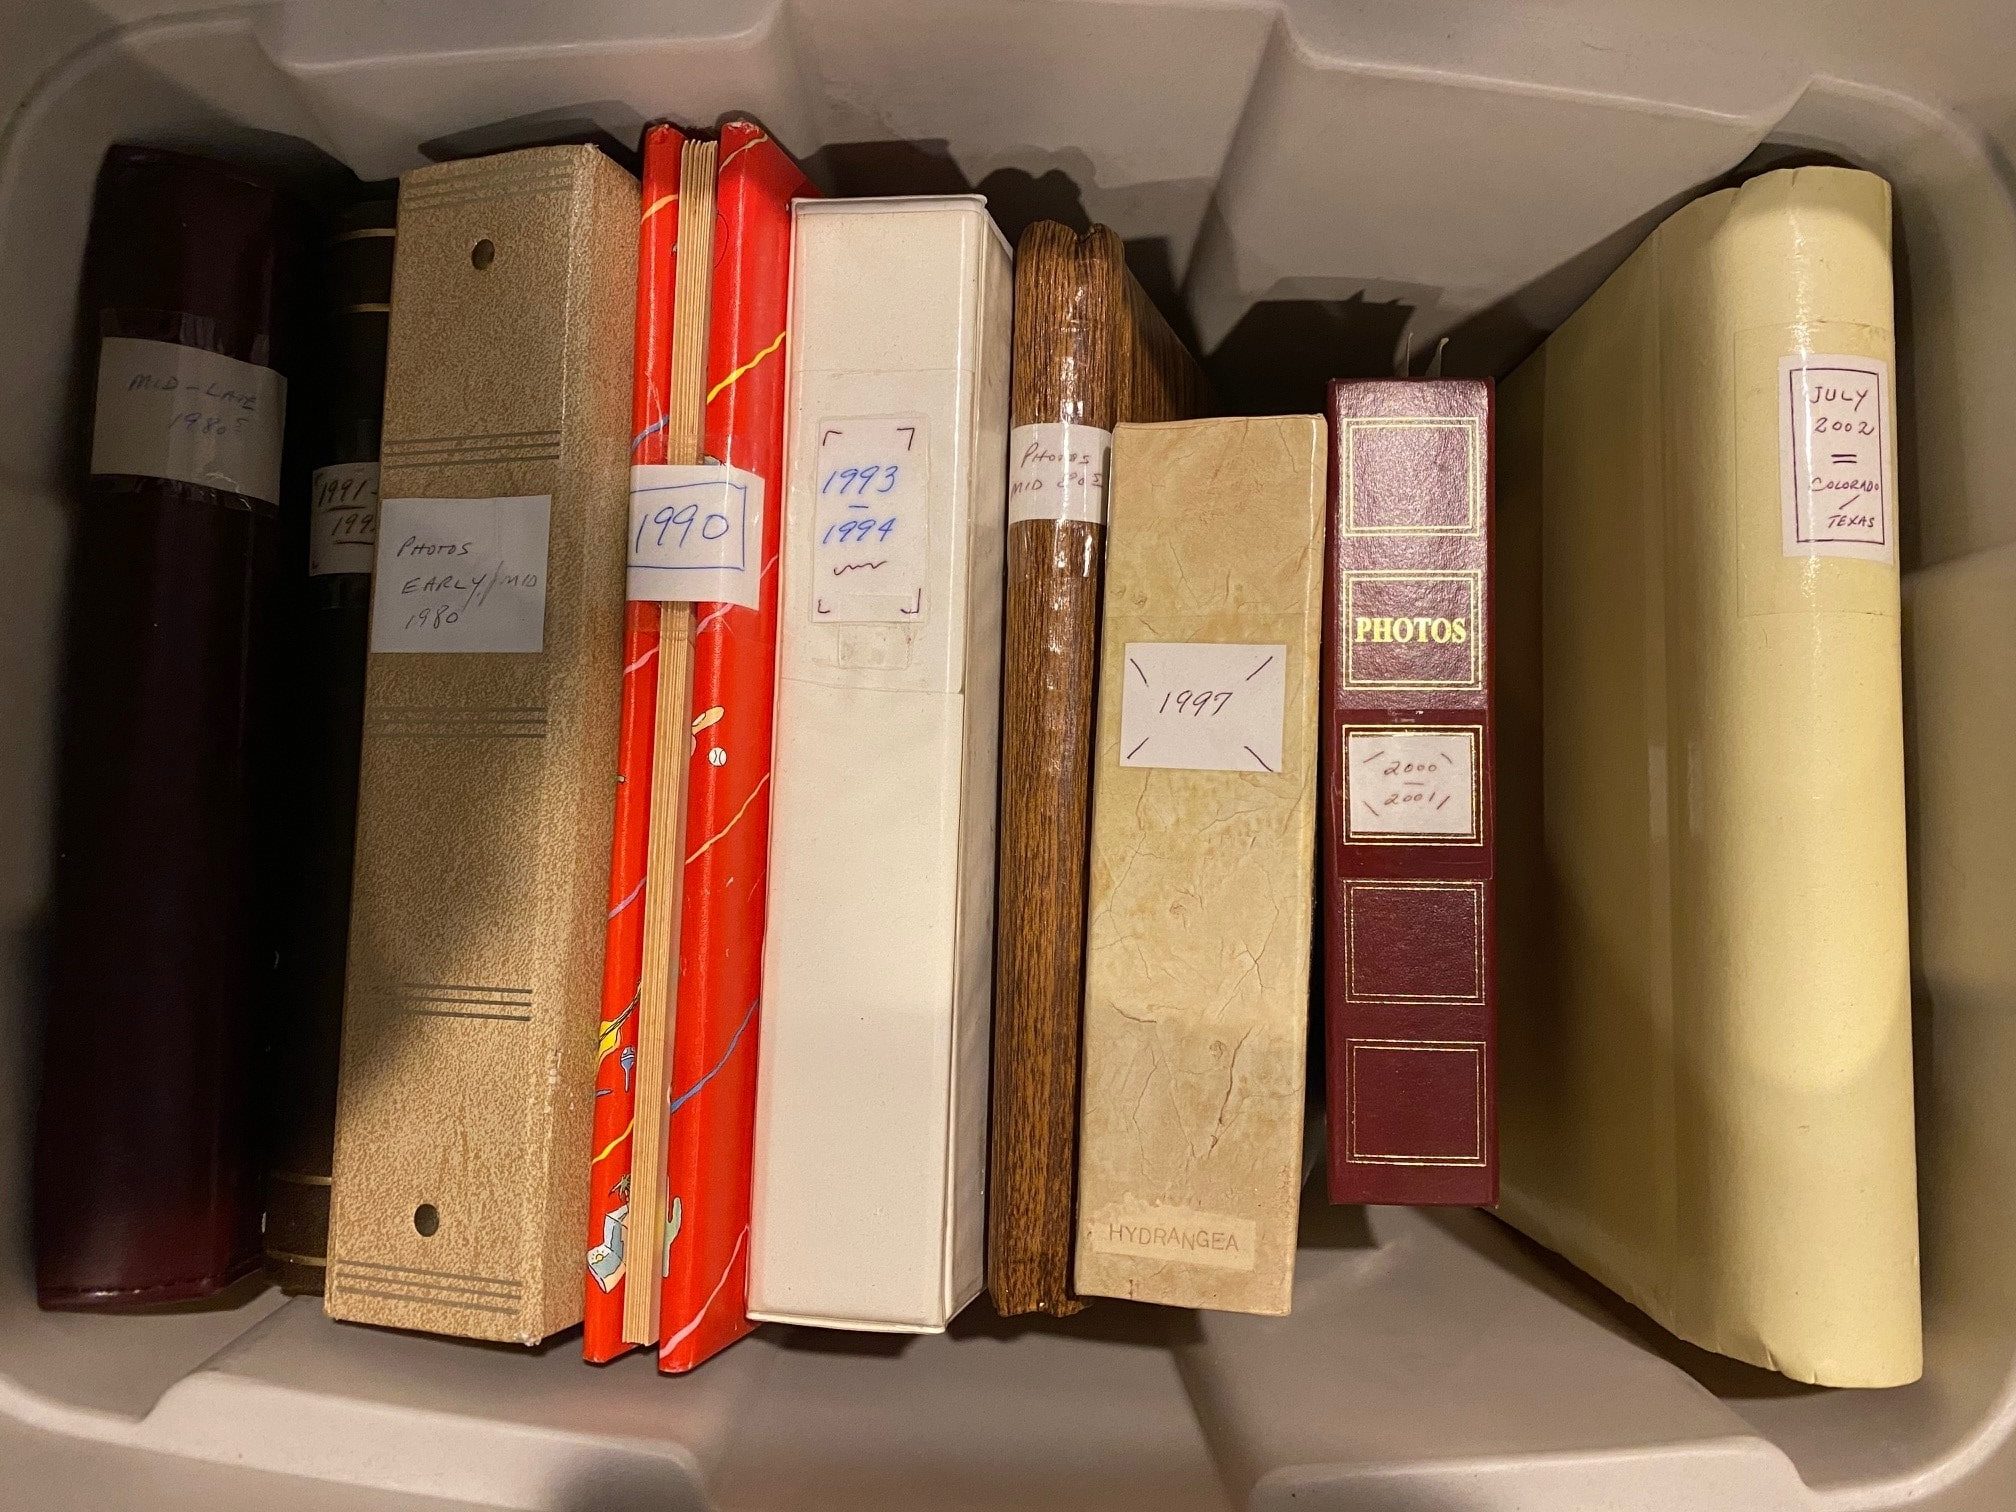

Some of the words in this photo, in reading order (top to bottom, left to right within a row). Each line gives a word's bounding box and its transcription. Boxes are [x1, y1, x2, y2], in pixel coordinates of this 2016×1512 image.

[1810, 385, 1869, 412] JULY
[1814, 416, 1875, 436] 2002
[822, 464, 899, 494] 1993
[1010, 479, 1043, 501] MID
[1811, 476, 1880, 493] COLORADO
[330, 513, 376, 536] 199
[635, 503, 730, 554] 1990
[822, 517, 897, 545] 1994
[1828, 514, 1875, 529] TEXAS
[396, 535, 474, 558] PHOTOS
[404, 604, 459, 630] 1980
[1354, 616, 1467, 644] PHOTOS
[1158, 689, 1234, 717] 1997
[1383, 760, 1438, 776] 2000
[1383, 791, 1436, 806] 2001
[1108, 1222, 1240, 1253] HYDRANGEA
